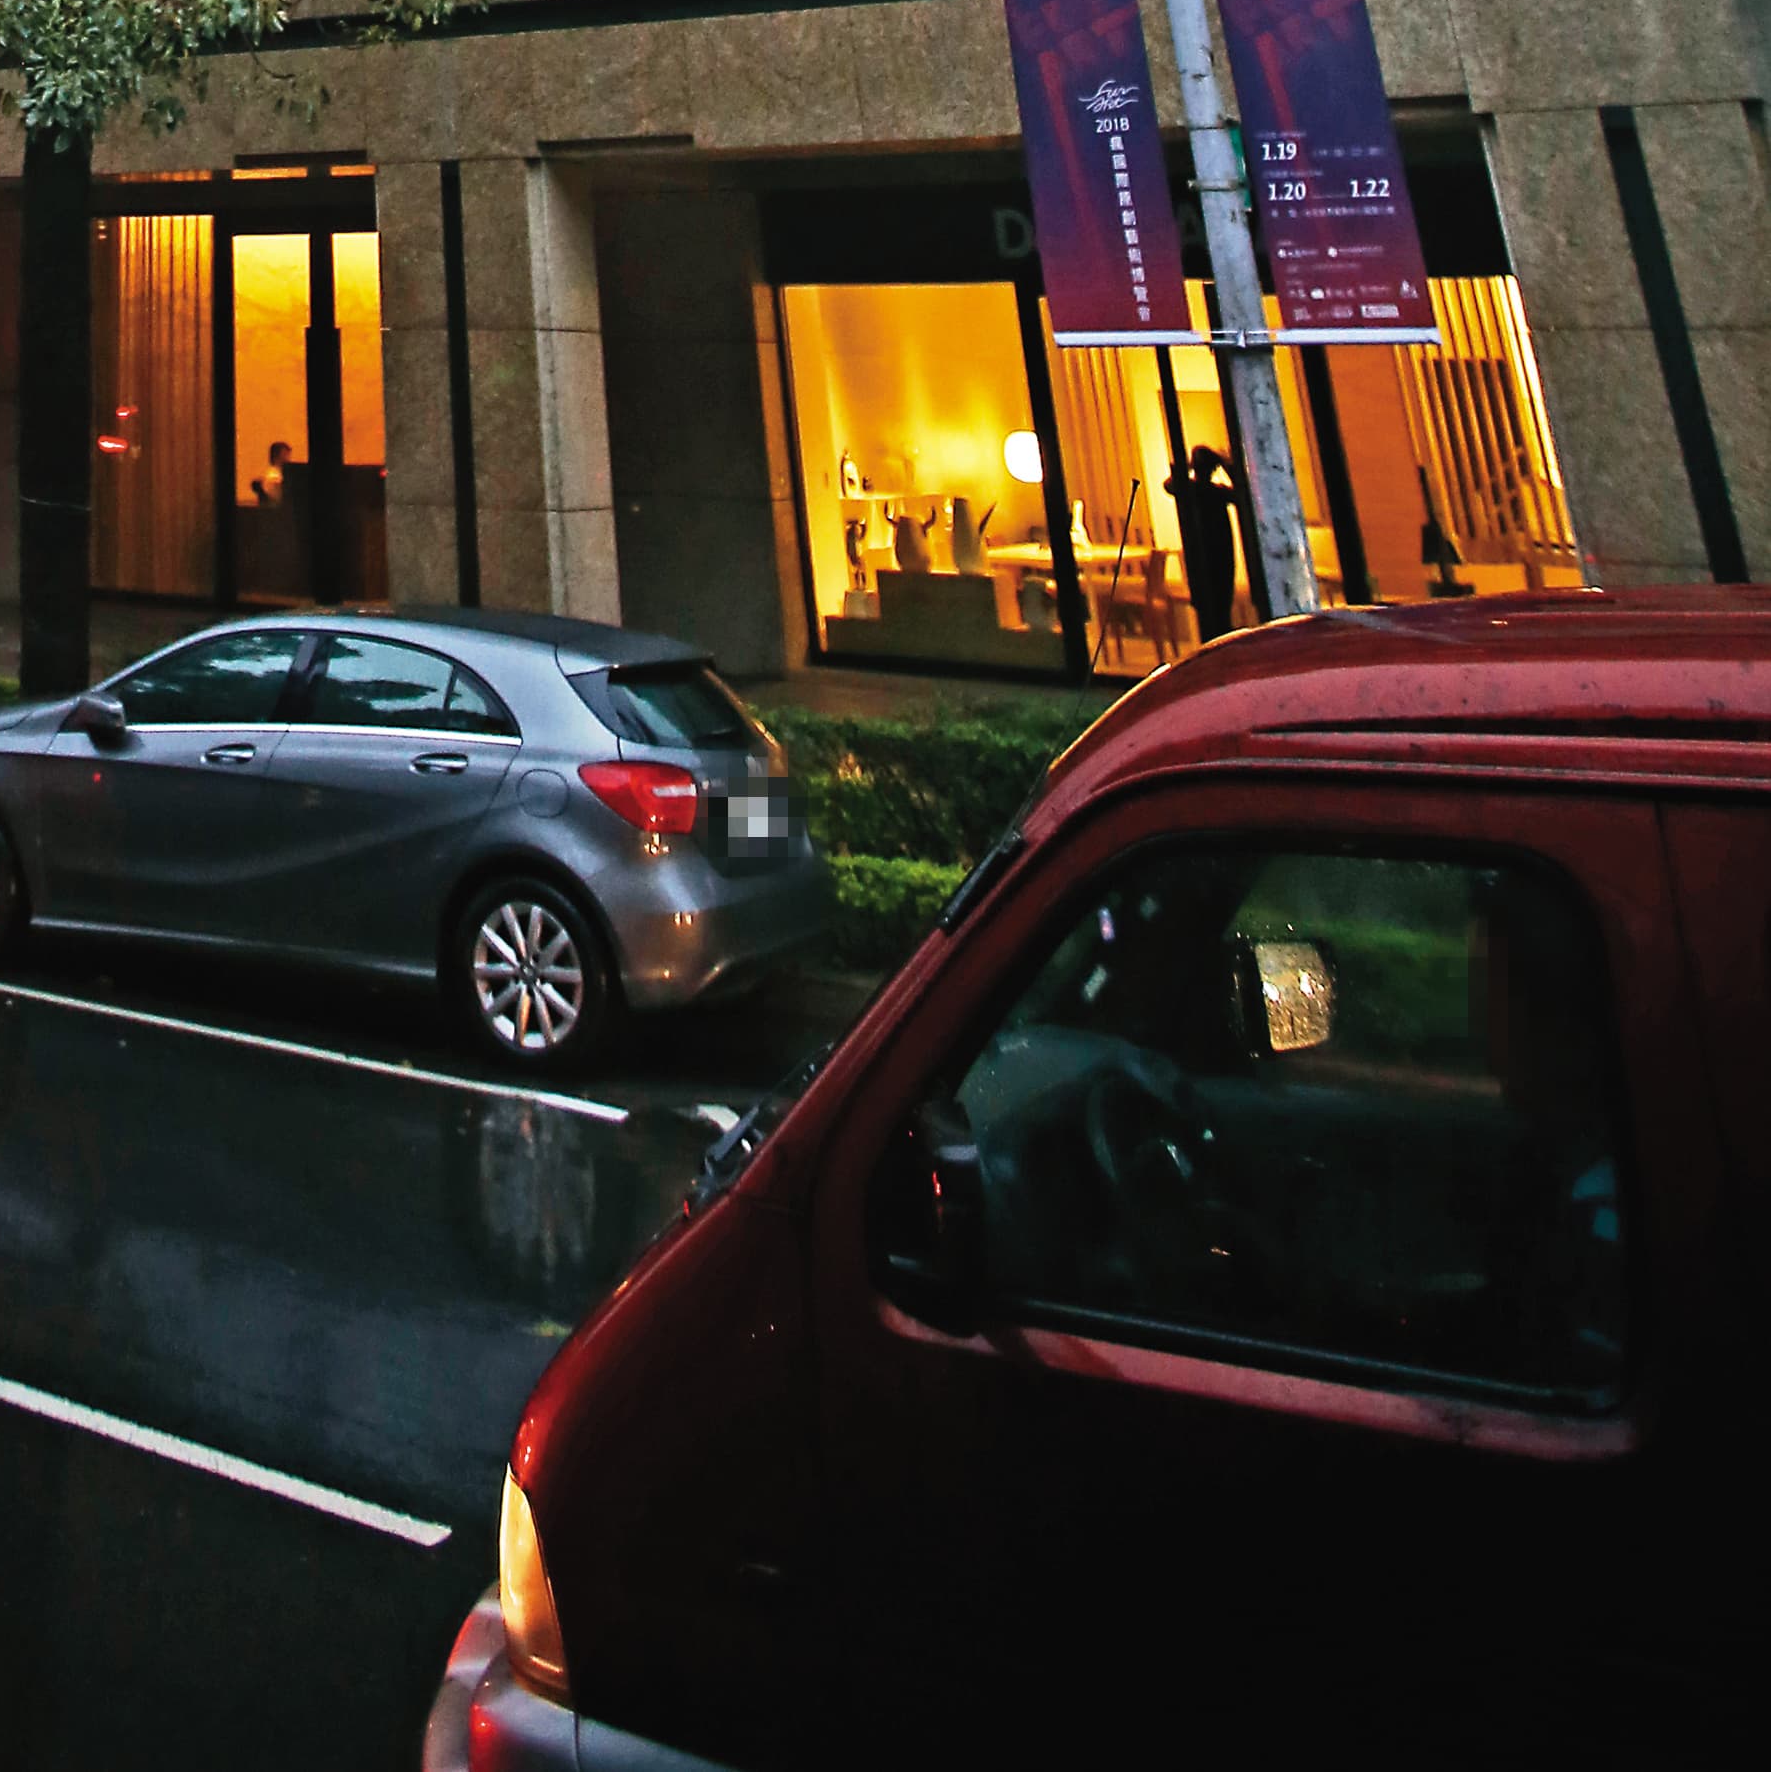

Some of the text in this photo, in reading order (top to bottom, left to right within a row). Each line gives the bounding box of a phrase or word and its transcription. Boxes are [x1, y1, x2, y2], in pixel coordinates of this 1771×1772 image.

[1095, 117, 1130, 134] 2018
[1261, 142, 1297, 161] 1.19
[1268, 178, 1391, 201] 1.20 1.22
